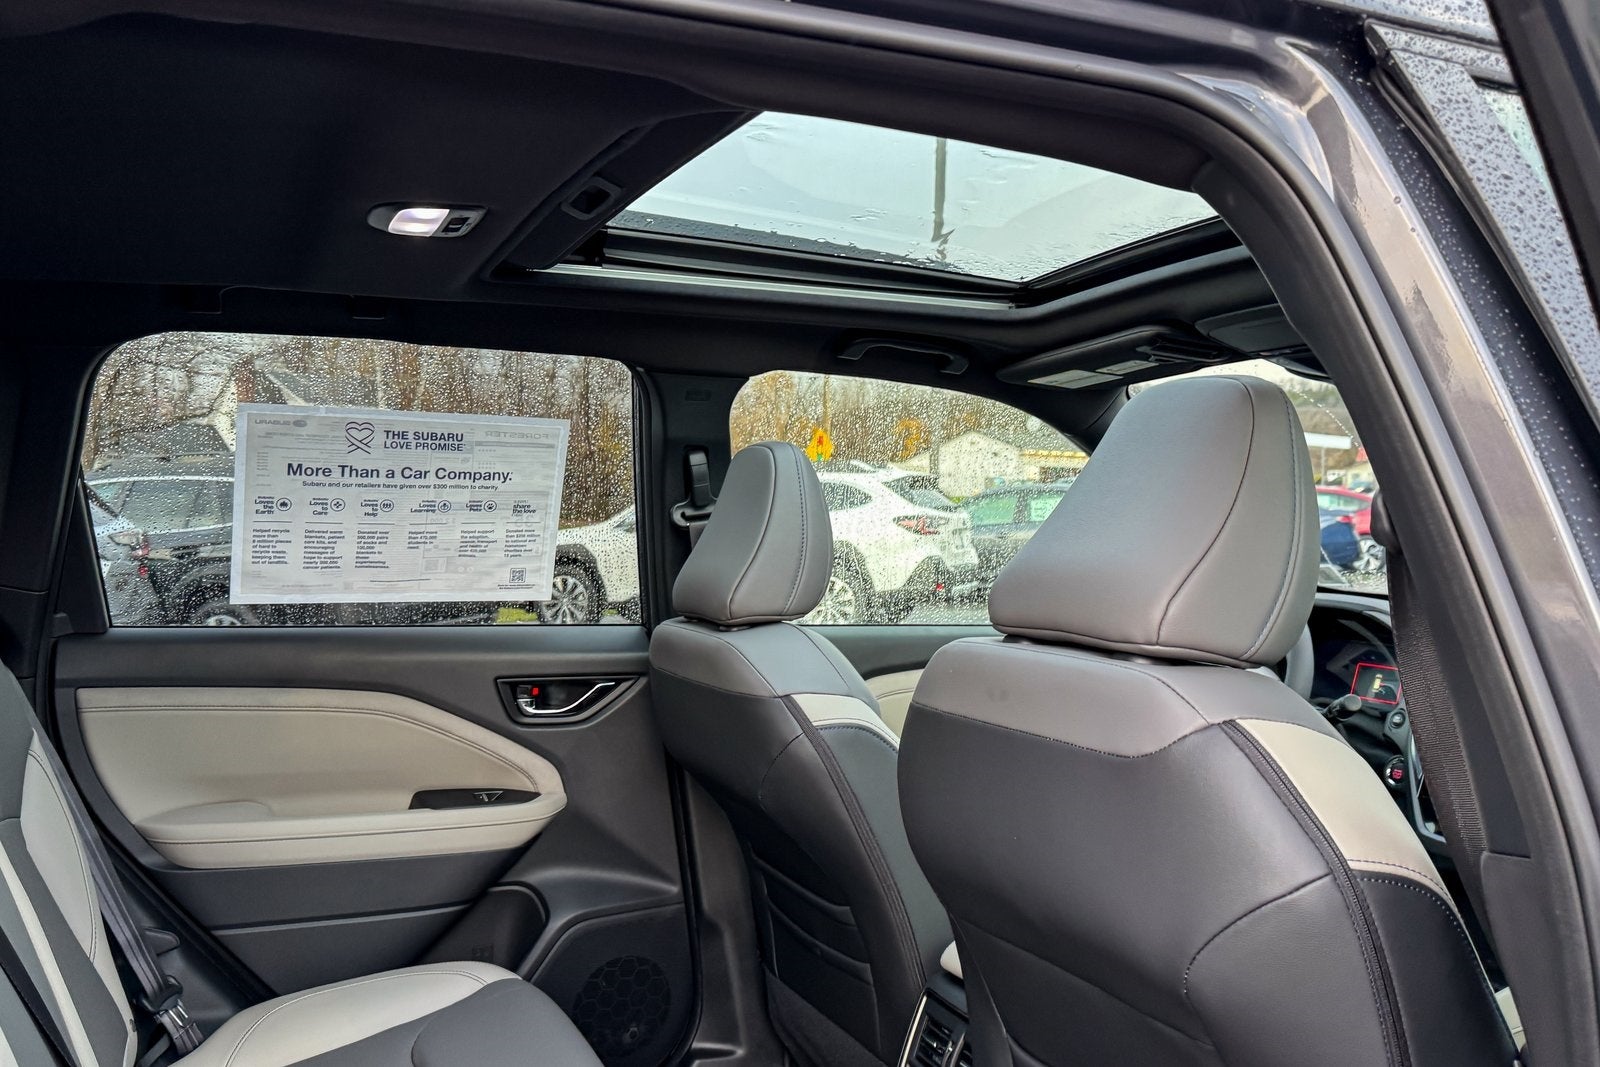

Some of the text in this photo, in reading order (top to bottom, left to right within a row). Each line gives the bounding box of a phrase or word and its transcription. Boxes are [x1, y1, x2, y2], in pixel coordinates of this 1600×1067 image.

[383, 430, 464, 442] THE SUBARU
[384, 440, 464, 452] LOVE PROMISE
[287, 463, 512, 484] More Than a Car Company.
